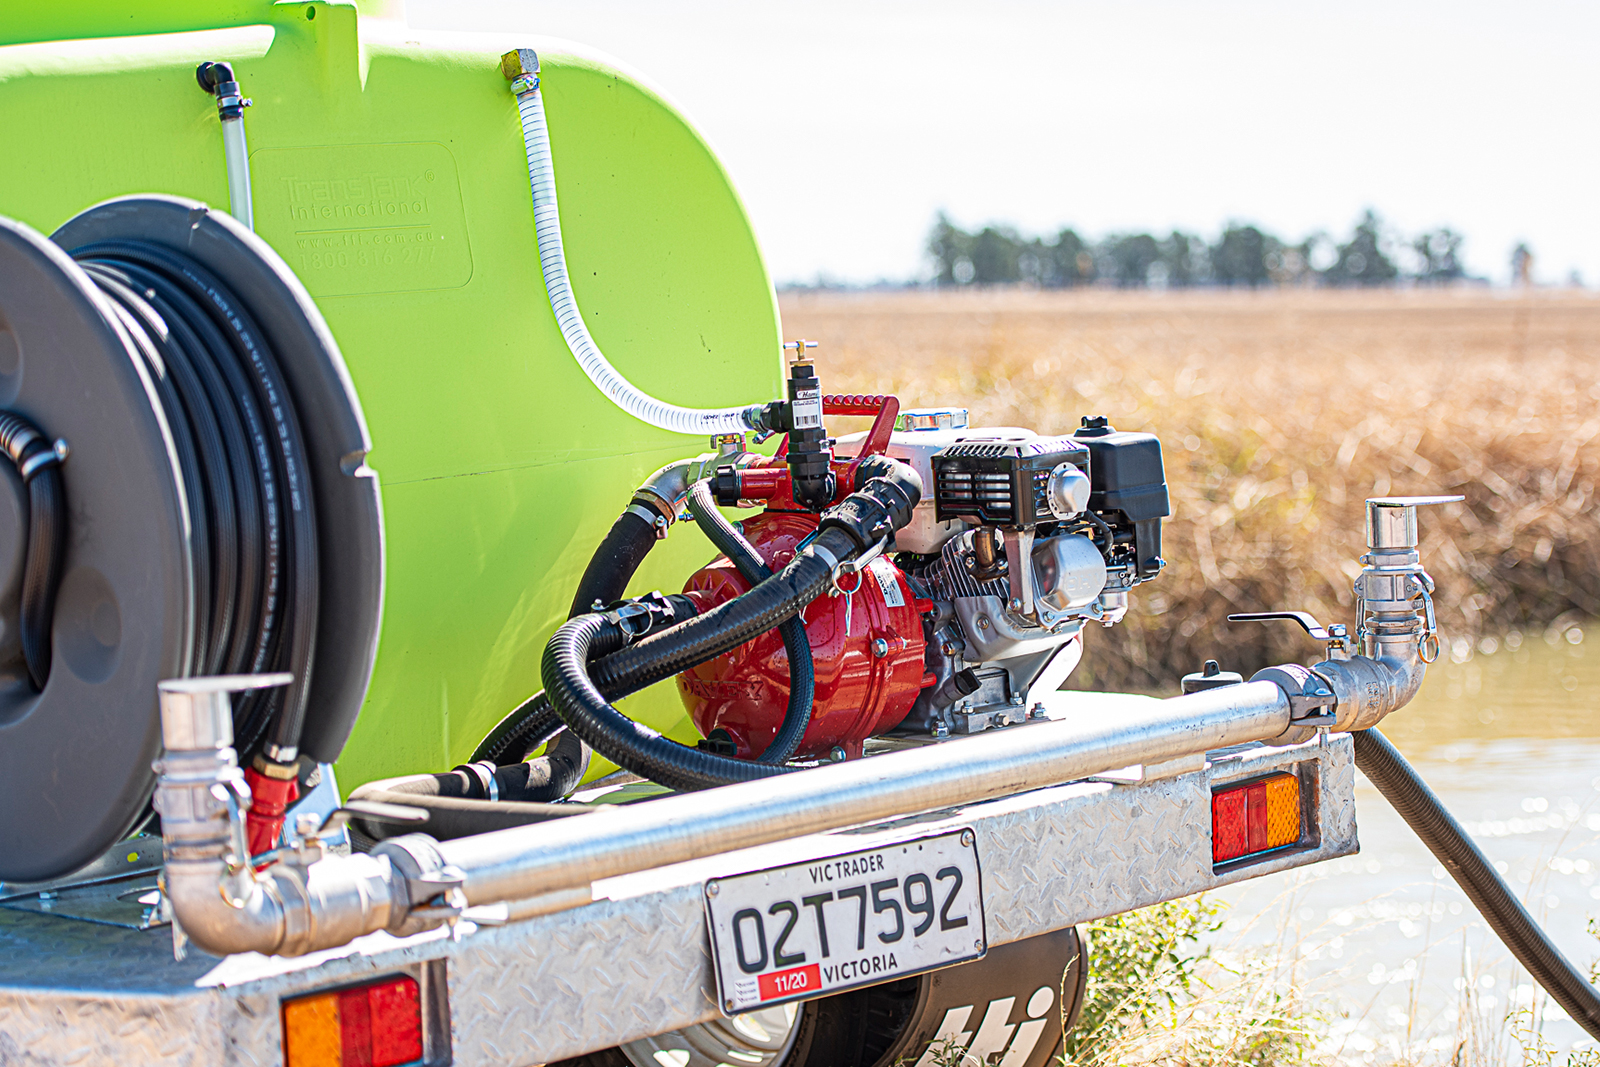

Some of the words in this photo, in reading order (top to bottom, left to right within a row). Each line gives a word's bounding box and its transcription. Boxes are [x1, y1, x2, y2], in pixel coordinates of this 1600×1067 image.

[290, 198, 429, 220] International
[297, 232, 434, 249] www.tti.com.au
[300, 251, 348, 270] 1800
[357, 249, 394, 267] 816
[401, 246, 436, 263] 277
[679, 675, 764, 701] DAVEY
[809, 863, 833, 884] VIC
[835, 854, 885, 879] TRADER
[732, 866, 969, 974] 02T7592
[823, 952, 898, 984] VICTORIA
[774, 971, 808, 993] 11/20
